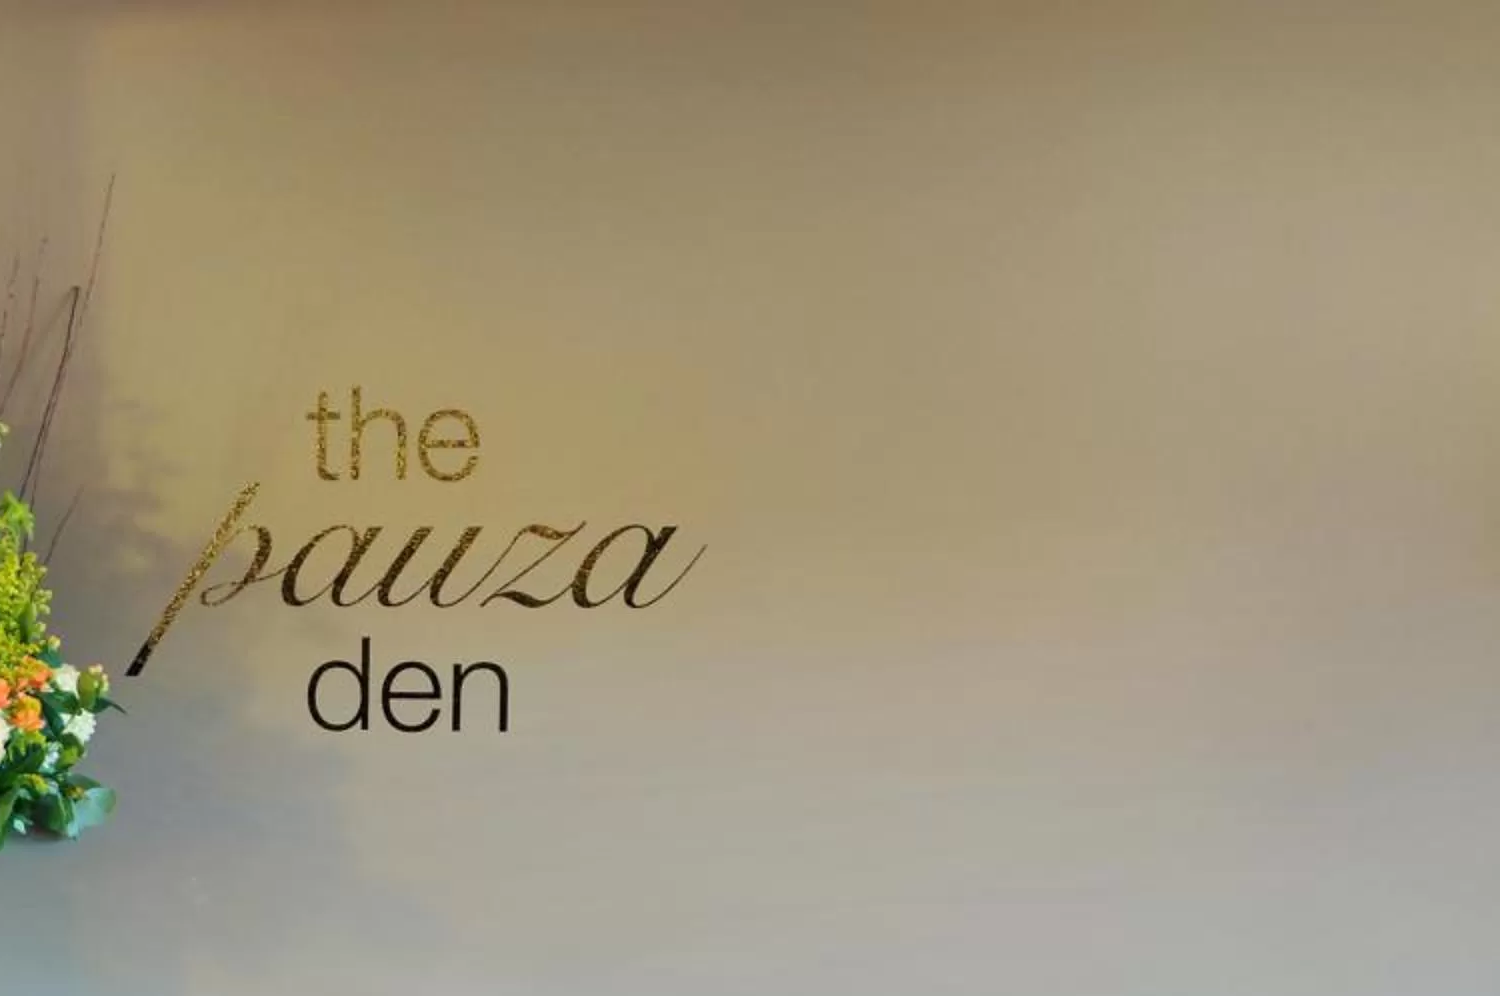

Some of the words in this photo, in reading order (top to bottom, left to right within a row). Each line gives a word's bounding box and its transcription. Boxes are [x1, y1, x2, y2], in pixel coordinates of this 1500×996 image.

[306, 384, 481, 482] the
[125, 480, 708, 677] pauza
[307, 636, 509, 733] den
